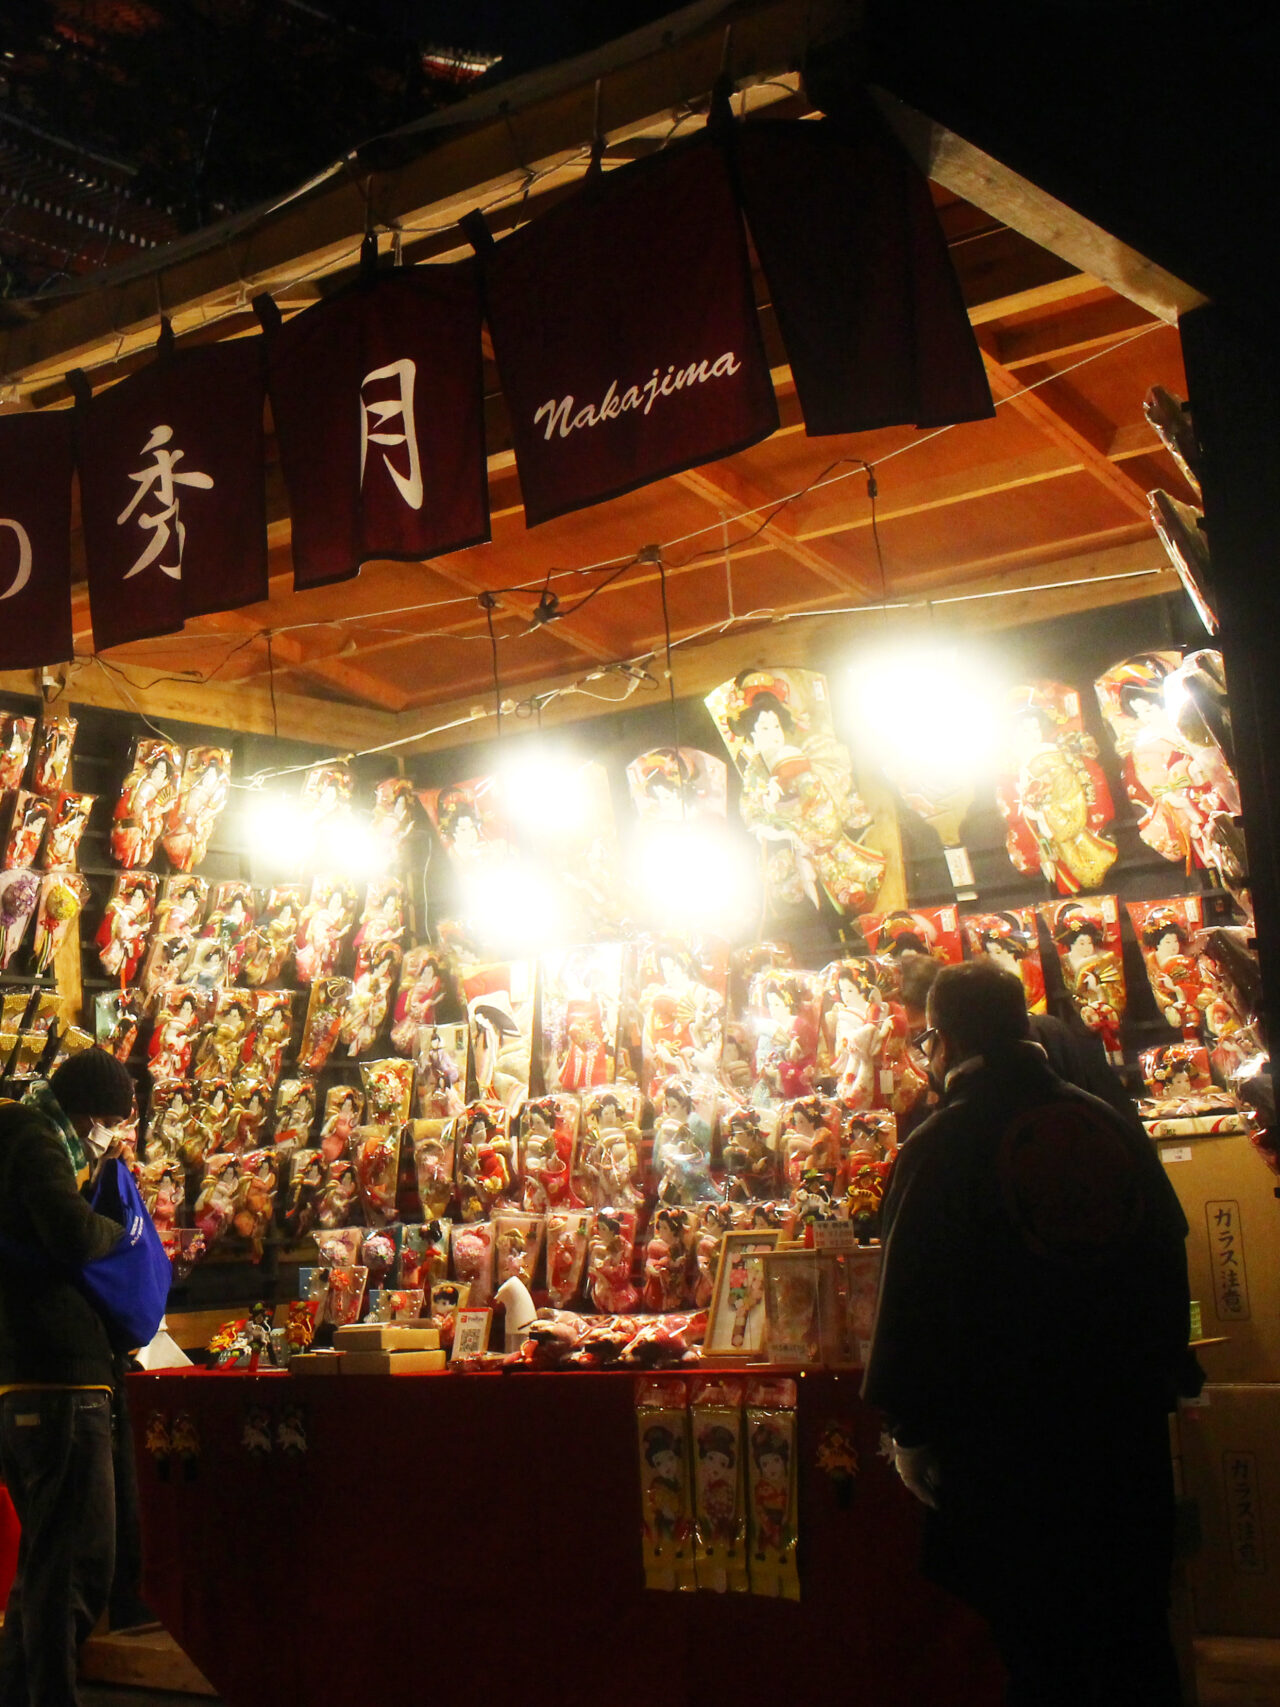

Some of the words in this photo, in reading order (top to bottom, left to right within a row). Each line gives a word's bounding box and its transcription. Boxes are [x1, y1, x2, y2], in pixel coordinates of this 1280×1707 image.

[533, 351, 742, 440] Nakajima
[1213, 1207, 1241, 1313] ガラス注意
